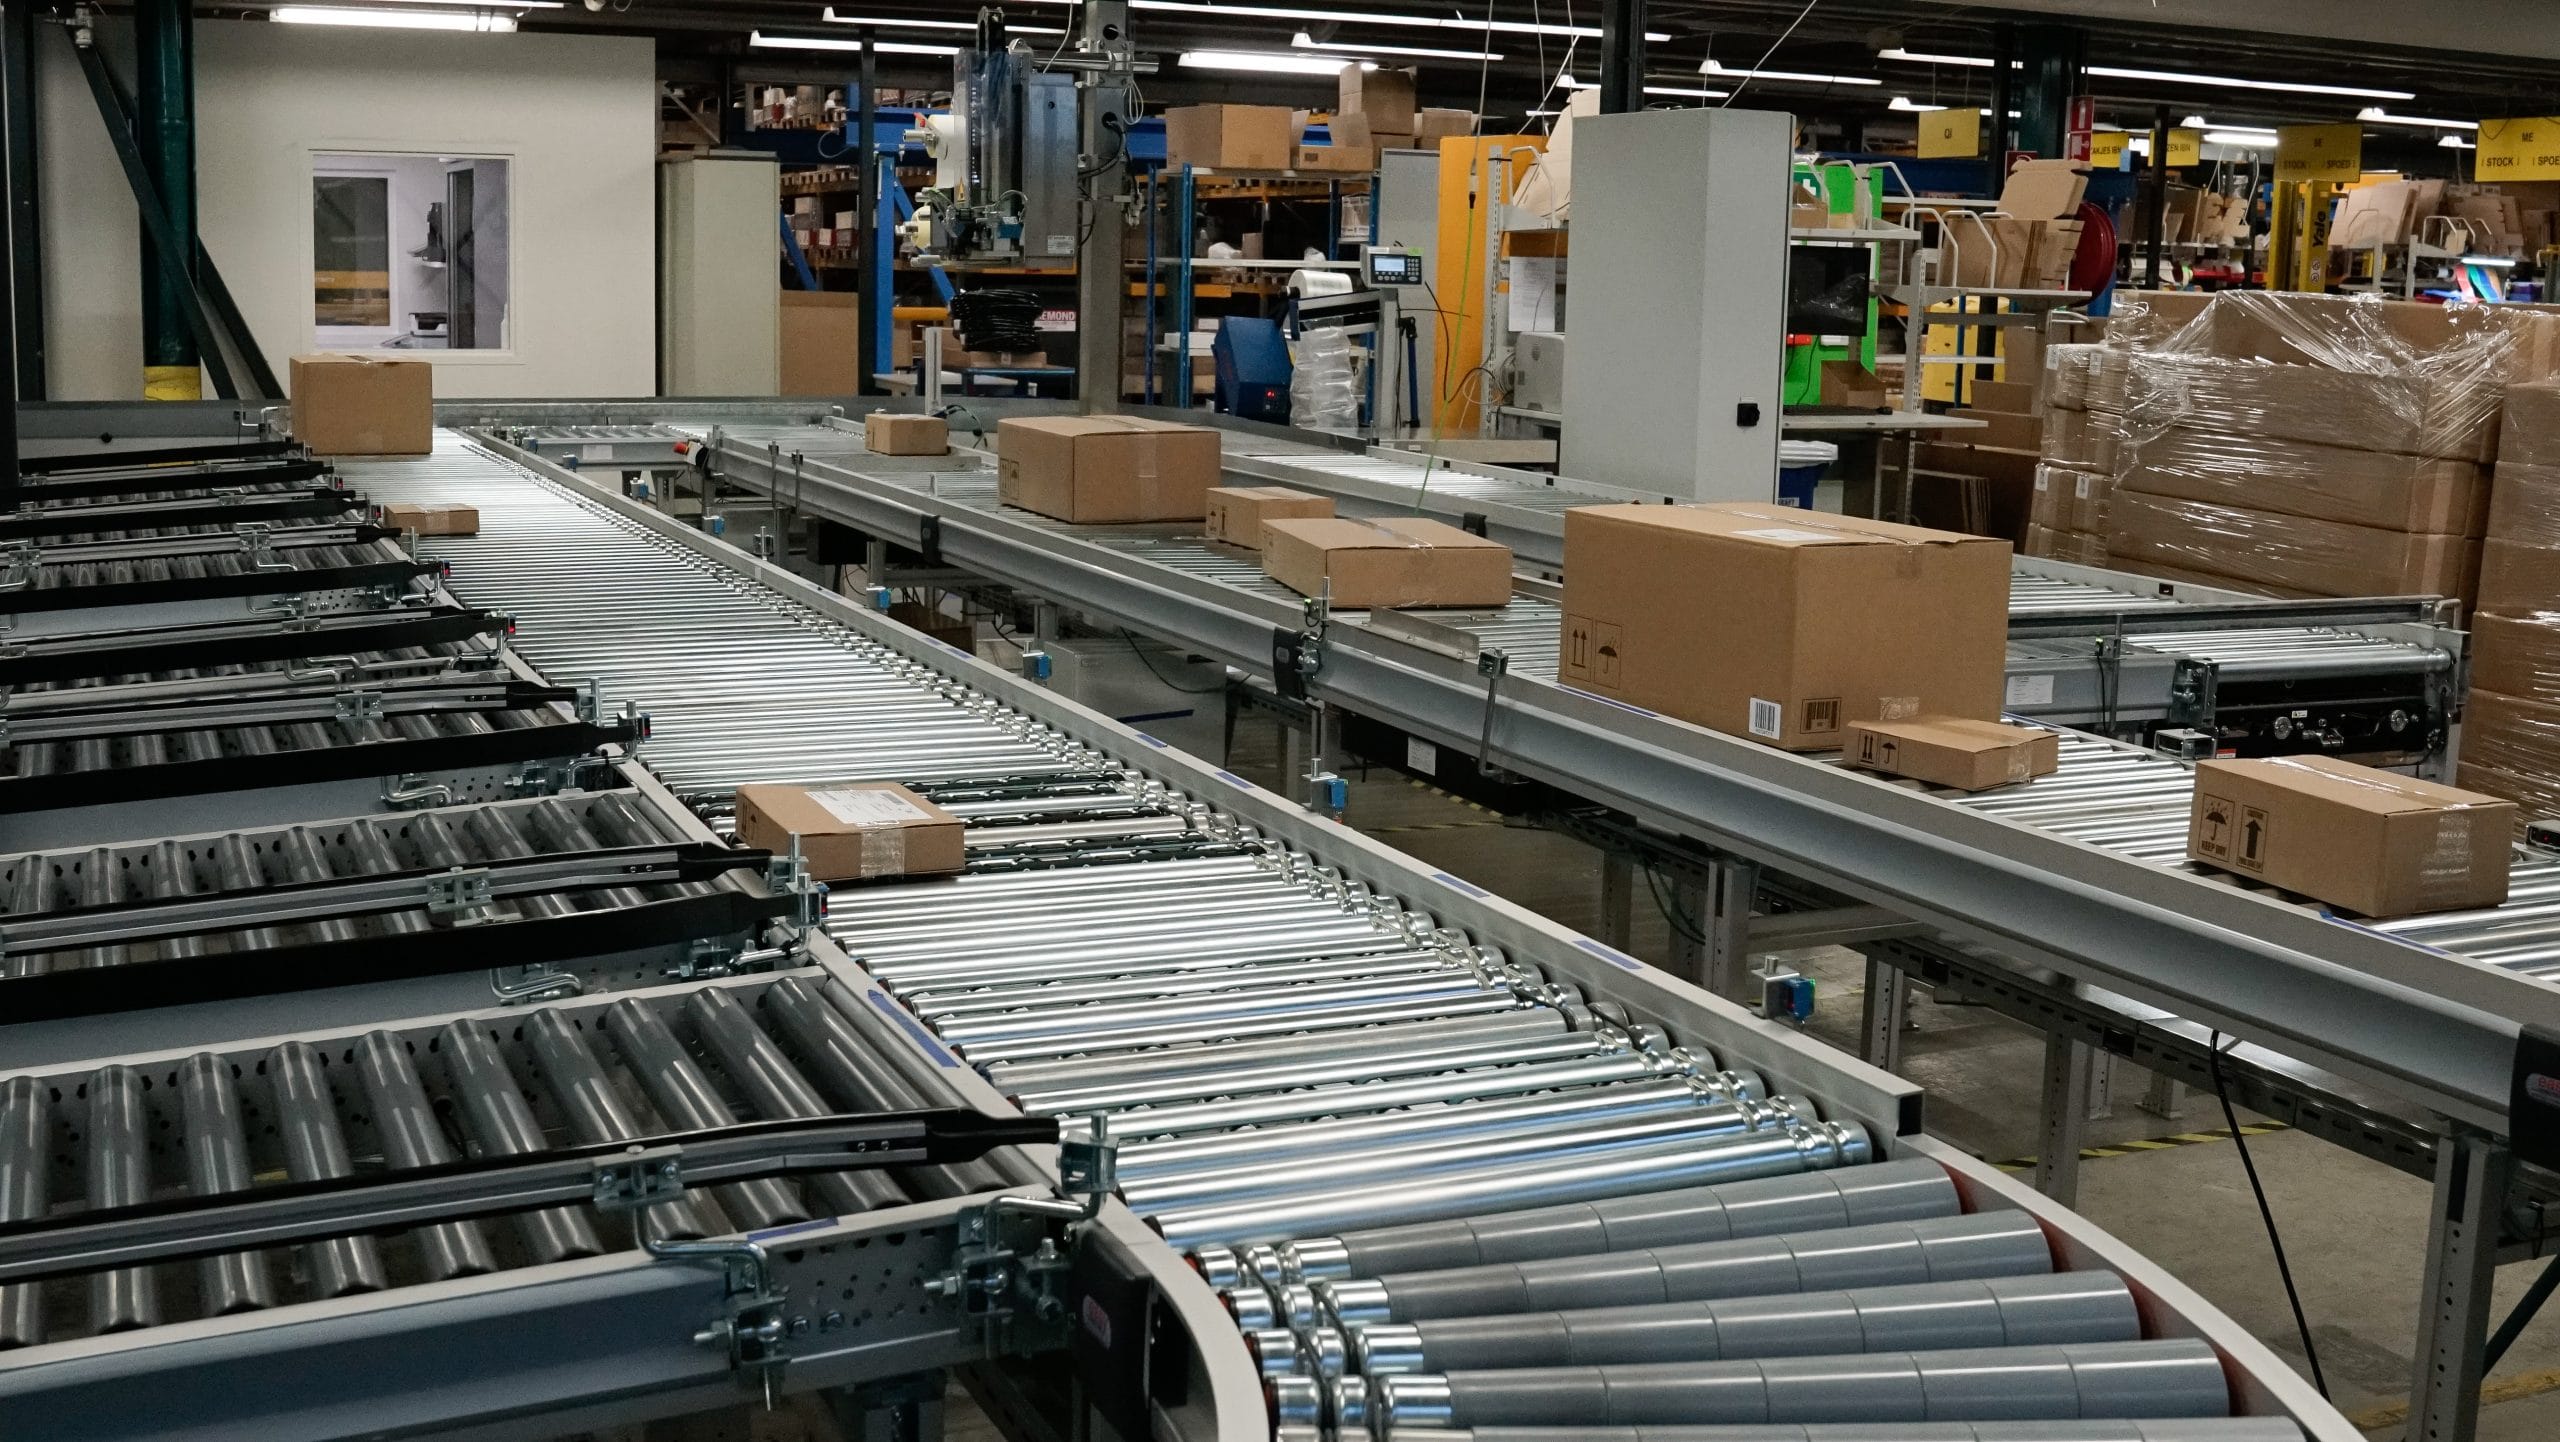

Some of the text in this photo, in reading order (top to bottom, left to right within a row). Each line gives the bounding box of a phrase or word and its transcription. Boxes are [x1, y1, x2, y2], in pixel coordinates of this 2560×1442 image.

[2521, 132, 2534, 142] ME
[2091, 146, 2110, 155] AKJES
[2167, 143, 2178, 152] ZEN
[2486, 157, 2514, 167] STOCK
[2312, 211, 2327, 248] Yale
[1039, 311, 1075, 321] EMOND
[2201, 840, 2215, 852] KEEP
